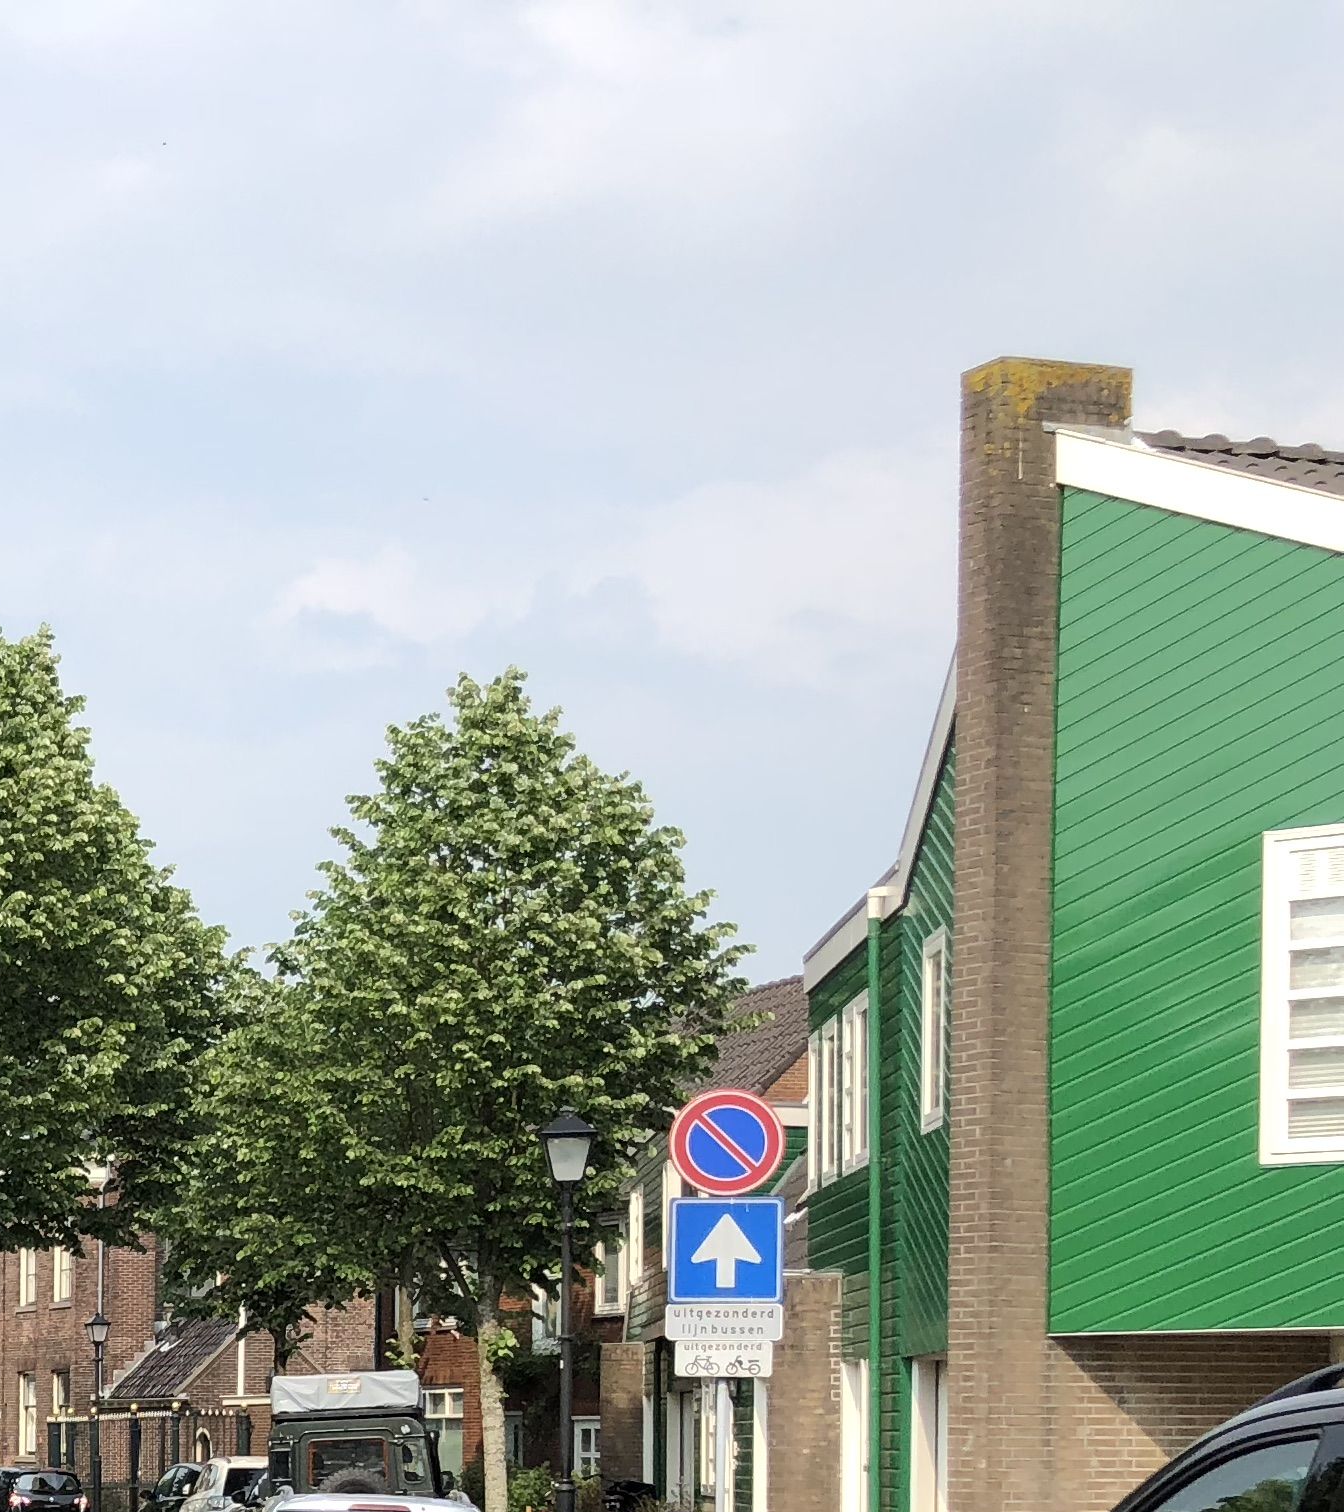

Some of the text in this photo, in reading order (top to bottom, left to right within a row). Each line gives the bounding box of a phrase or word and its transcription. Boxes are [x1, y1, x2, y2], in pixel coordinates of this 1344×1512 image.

[673, 1308, 774, 1320] uitgezonderd
[682, 1324, 764, 1337] lijnbussen
[684, 1342, 762, 1352] uitgezonderd
